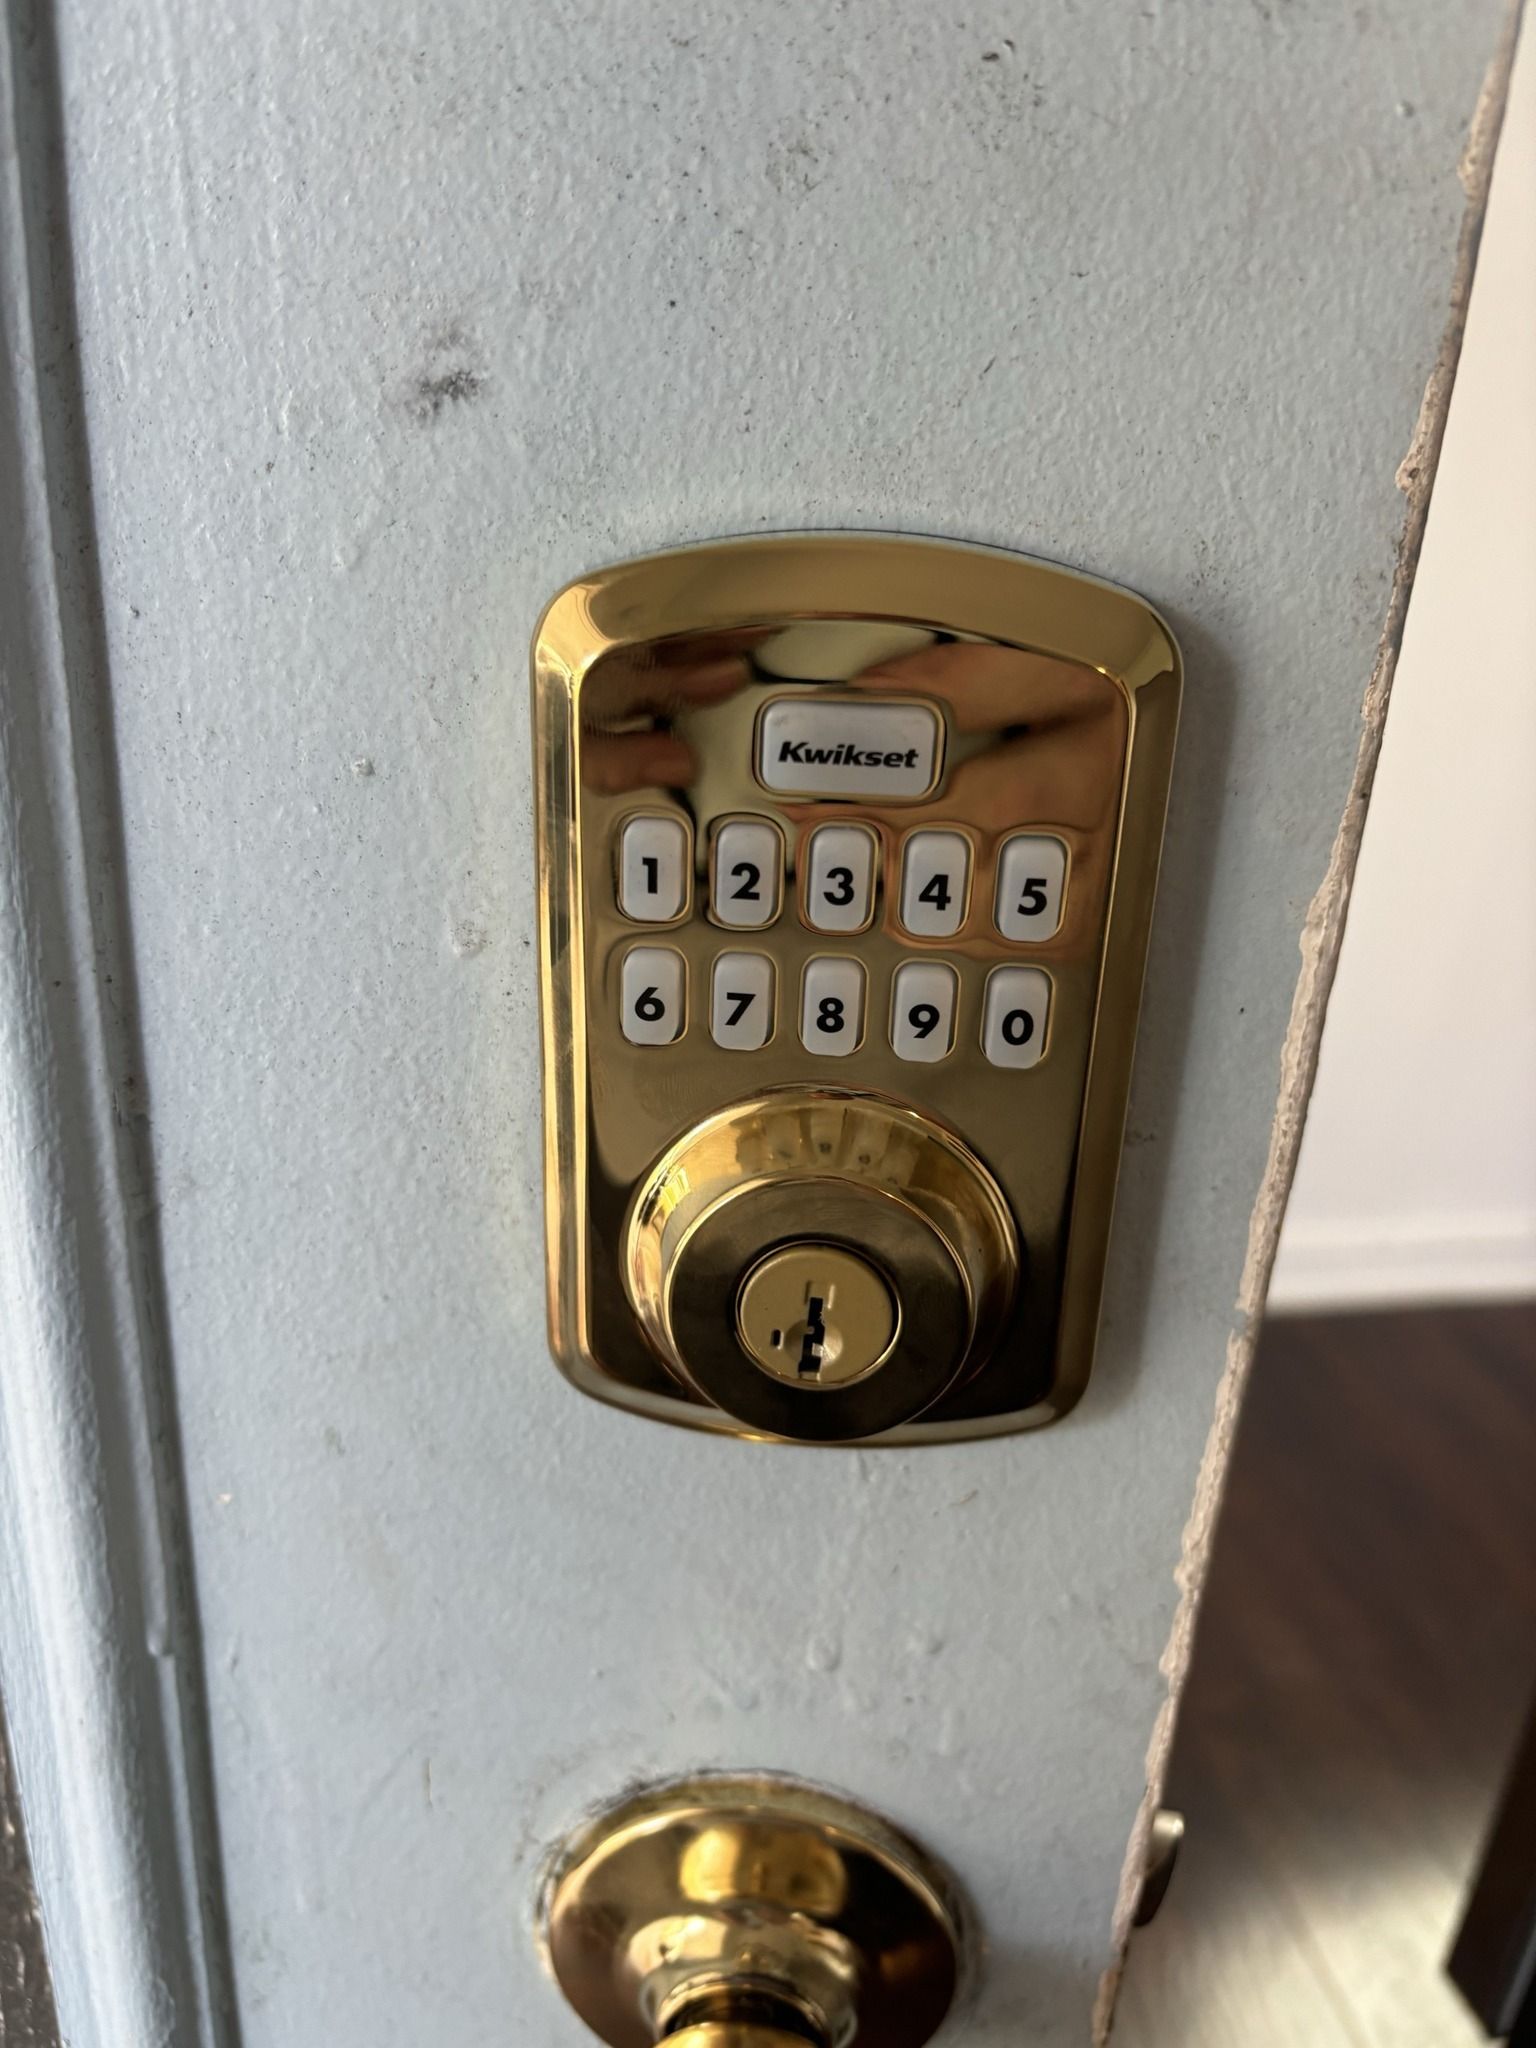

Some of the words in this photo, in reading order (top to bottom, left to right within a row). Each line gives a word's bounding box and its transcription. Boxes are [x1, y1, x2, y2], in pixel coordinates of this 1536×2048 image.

[779, 742, 918, 768] Kwikset
[643, 858, 657, 893] 1
[731, 863, 760, 900] 2
[824, 867, 854, 905] 3
[919, 874, 951, 910] 4
[1018, 878, 1047, 915] 5
[635, 987, 665, 1021] 6
[725, 992, 756, 1025] 7
[817, 998, 844, 1033] 8
[909, 1004, 940, 1038] 9
[1002, 1010, 1033, 1045] 0
